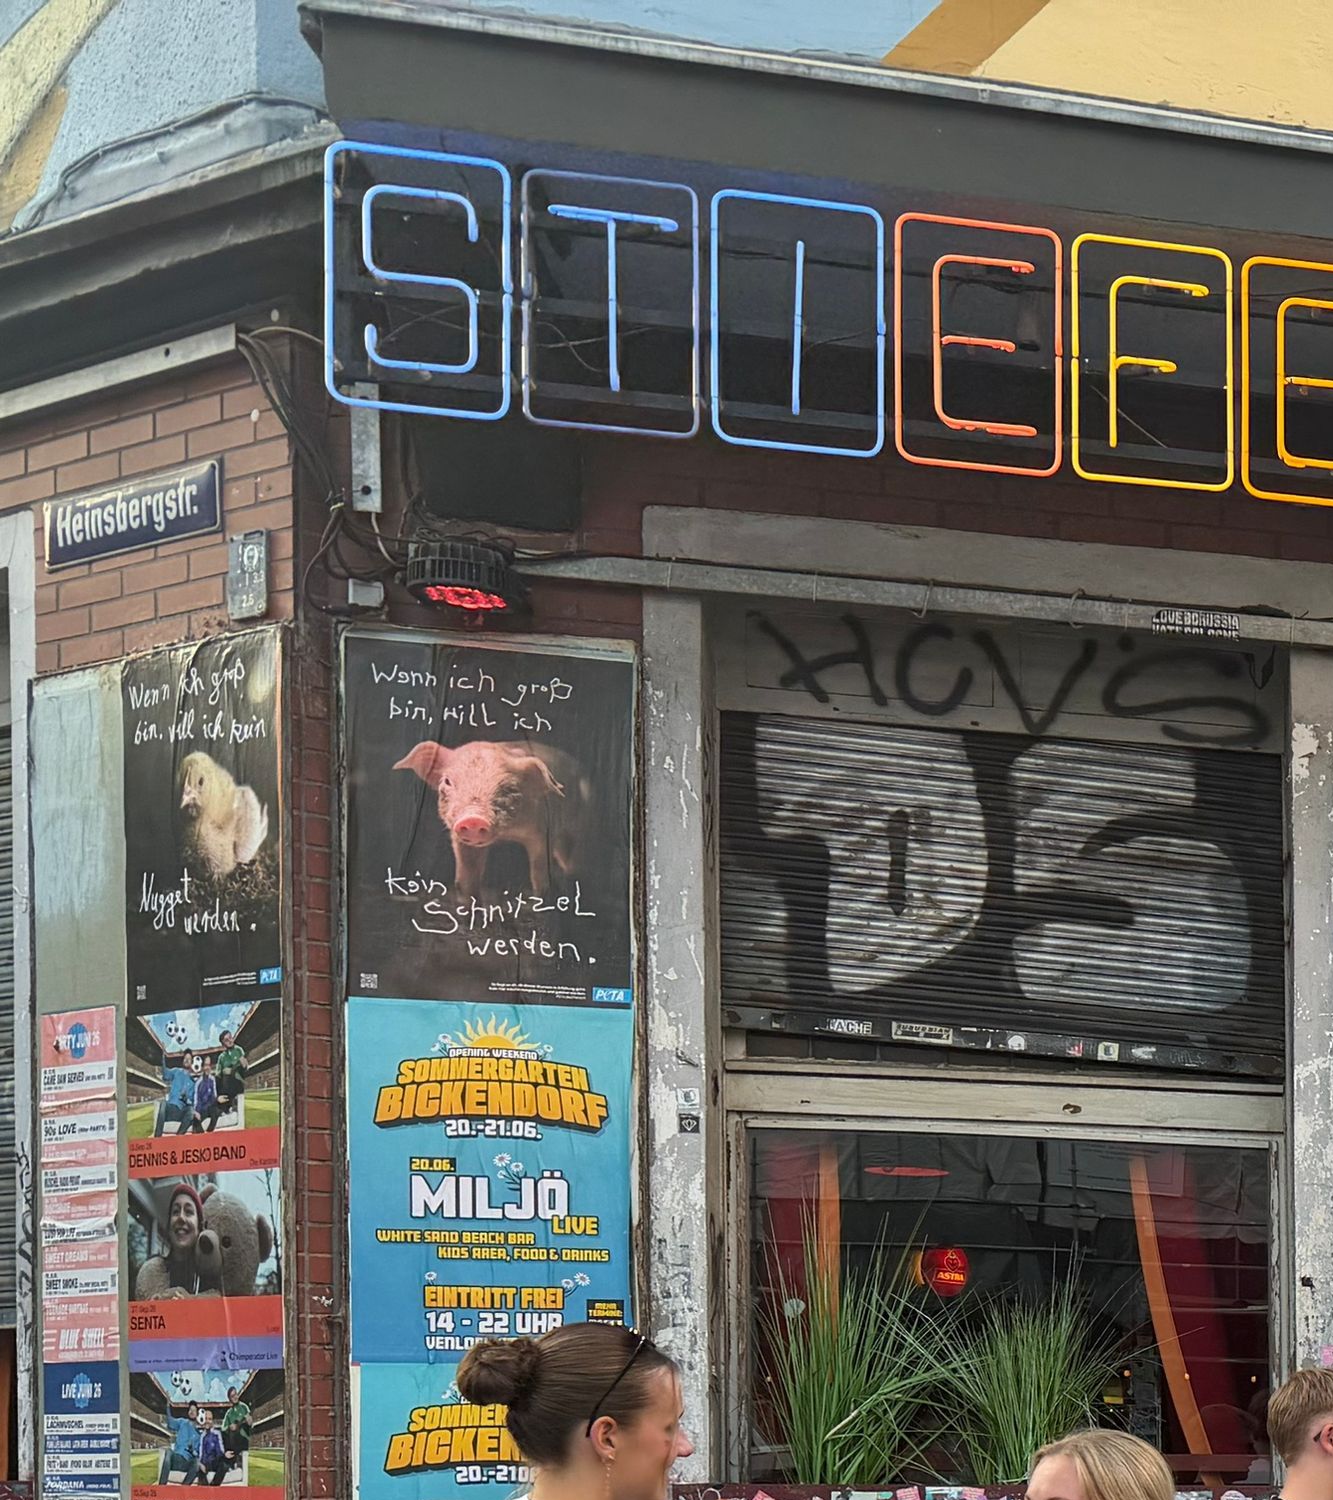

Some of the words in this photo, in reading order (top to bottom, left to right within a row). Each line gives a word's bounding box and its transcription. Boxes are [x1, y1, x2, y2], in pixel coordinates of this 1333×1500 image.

[56, 482, 199, 548] Heinsbergstr.
[1184, 611, 1240, 630] BORUSSIA
[372, 663, 437, 687] Wenn
[449, 665, 494, 693] ich
[501, 677, 573, 706] groß
[130, 683, 170, 710] Wenn
[389, 697, 432, 725] bin,
[444, 702, 496, 727] will
[513, 712, 552, 732] ich
[203, 714, 224, 740] ich
[385, 867, 447, 896] kein
[139, 868, 192, 930] Nugget
[467, 930, 597, 964] werden.
[449, 1048, 490, 1059] OPENING
[492, 1048, 538, 1060] WEEKEND
[397, 1057, 589, 1091] SOMMERGARTEN
[375, 1080, 609, 1129] BICKENDORF
[59, 1123, 77, 1135] LOVE
[445, 1119, 543, 1140] 20.-21.06.
[129, 1150, 169, 1169] DENNIS
[170, 1150, 179, 1165] &
[213, 1145, 246, 1160] BAND
[411, 1158, 455, 1171] 20.06.
[410, 1169, 571, 1220] MILJÖ
[376, 1229, 422, 1243] WHITE
[424, 1230, 460, 1243] SAND
[462, 1231, 504, 1244] BEACH
[507, 1232, 535, 1245] BAR
[551, 1215, 600, 1236] LIVE
[437, 1247, 469, 1260] KIDS
[472, 1247, 511, 1262] AREA,
[513, 1248, 547, 1260] FOOD
[561, 1249, 609, 1262] DRINKS
[424, 1286, 518, 1309] EINTRITT
[520, 1287, 565, 1309] FREI
[130, 1315, 166, 1331] SENTA
[425, 1311, 455, 1333] 14
[478, 1312, 510, 1334] 22
[62, 1383, 77, 1399] LIVE
